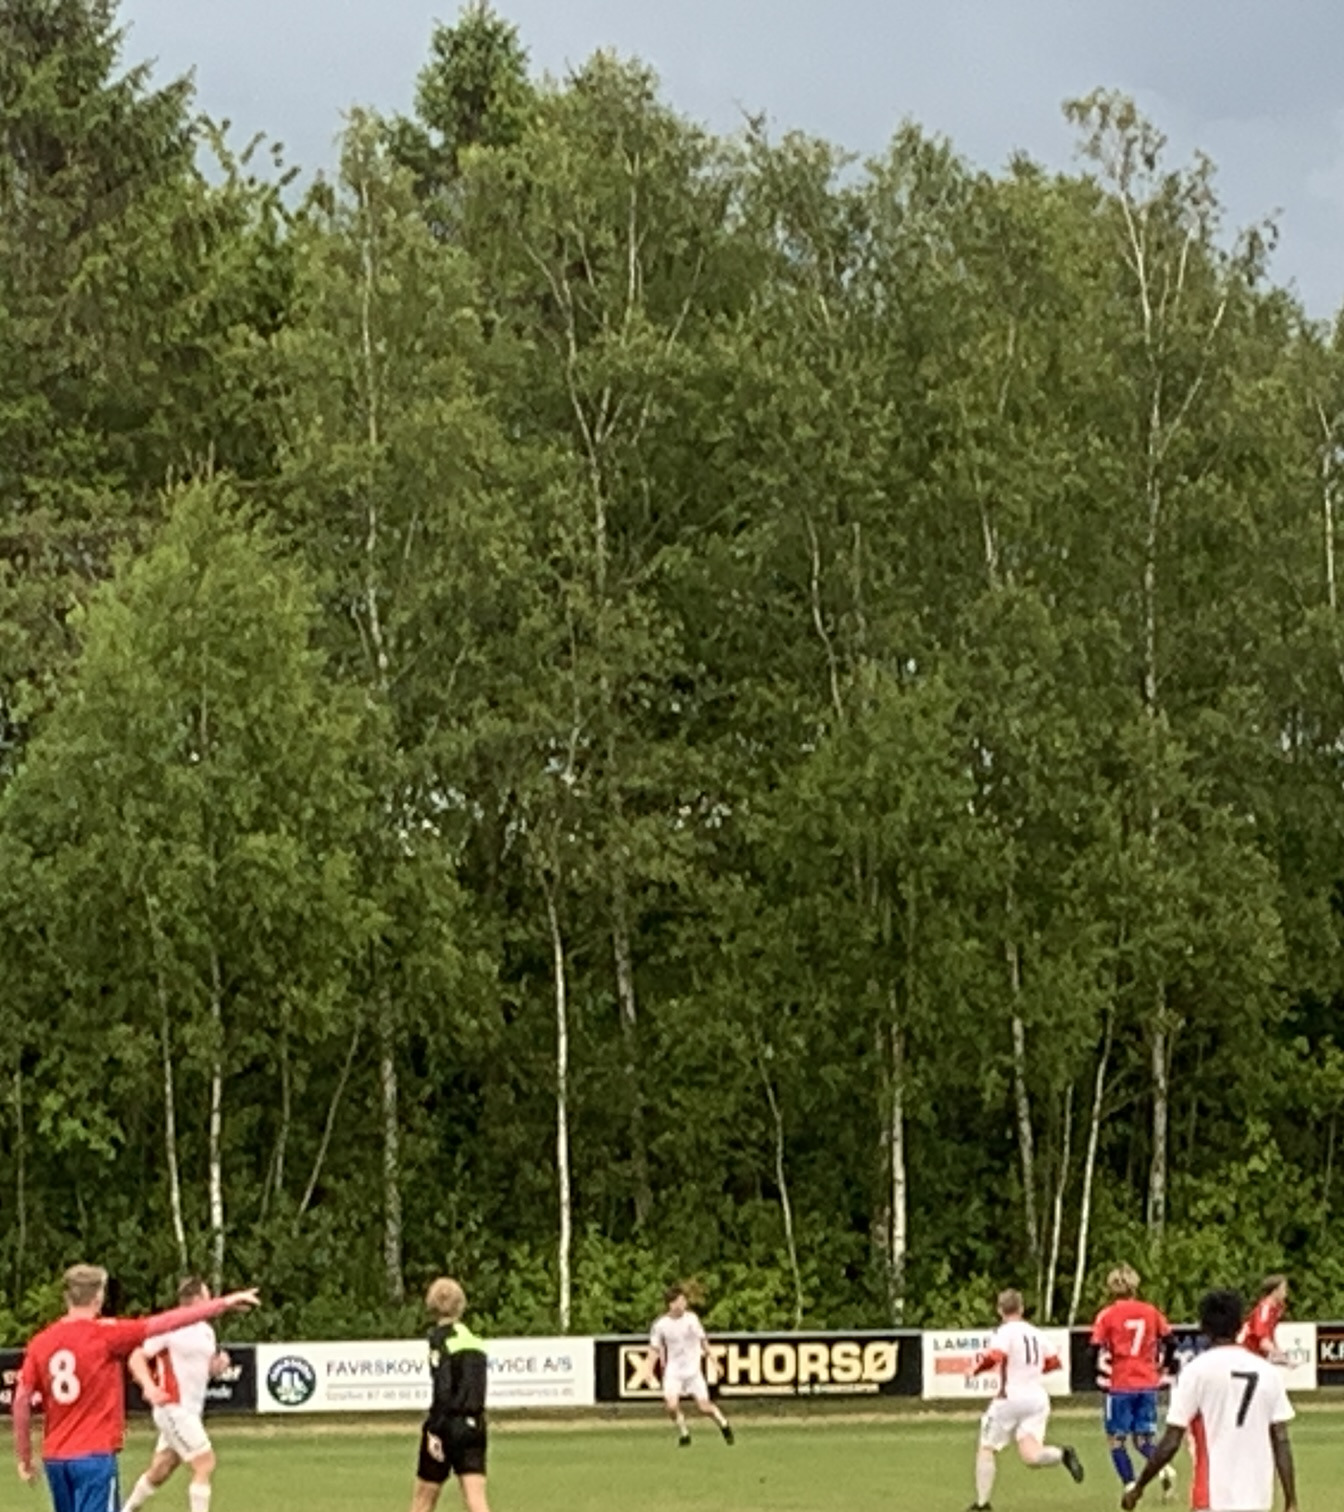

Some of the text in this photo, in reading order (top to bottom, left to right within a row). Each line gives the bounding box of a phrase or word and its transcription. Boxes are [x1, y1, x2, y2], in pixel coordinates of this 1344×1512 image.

[1023, 1335, 1040, 1366] 11
[1124, 1318, 1146, 1356] 7
[49, 1349, 81, 1405] 8
[327, 1360, 423, 1377] FAVRSKOV
[707, 1339, 899, 1385] THORSØ
[1230, 1371, 1260, 1427] 7
